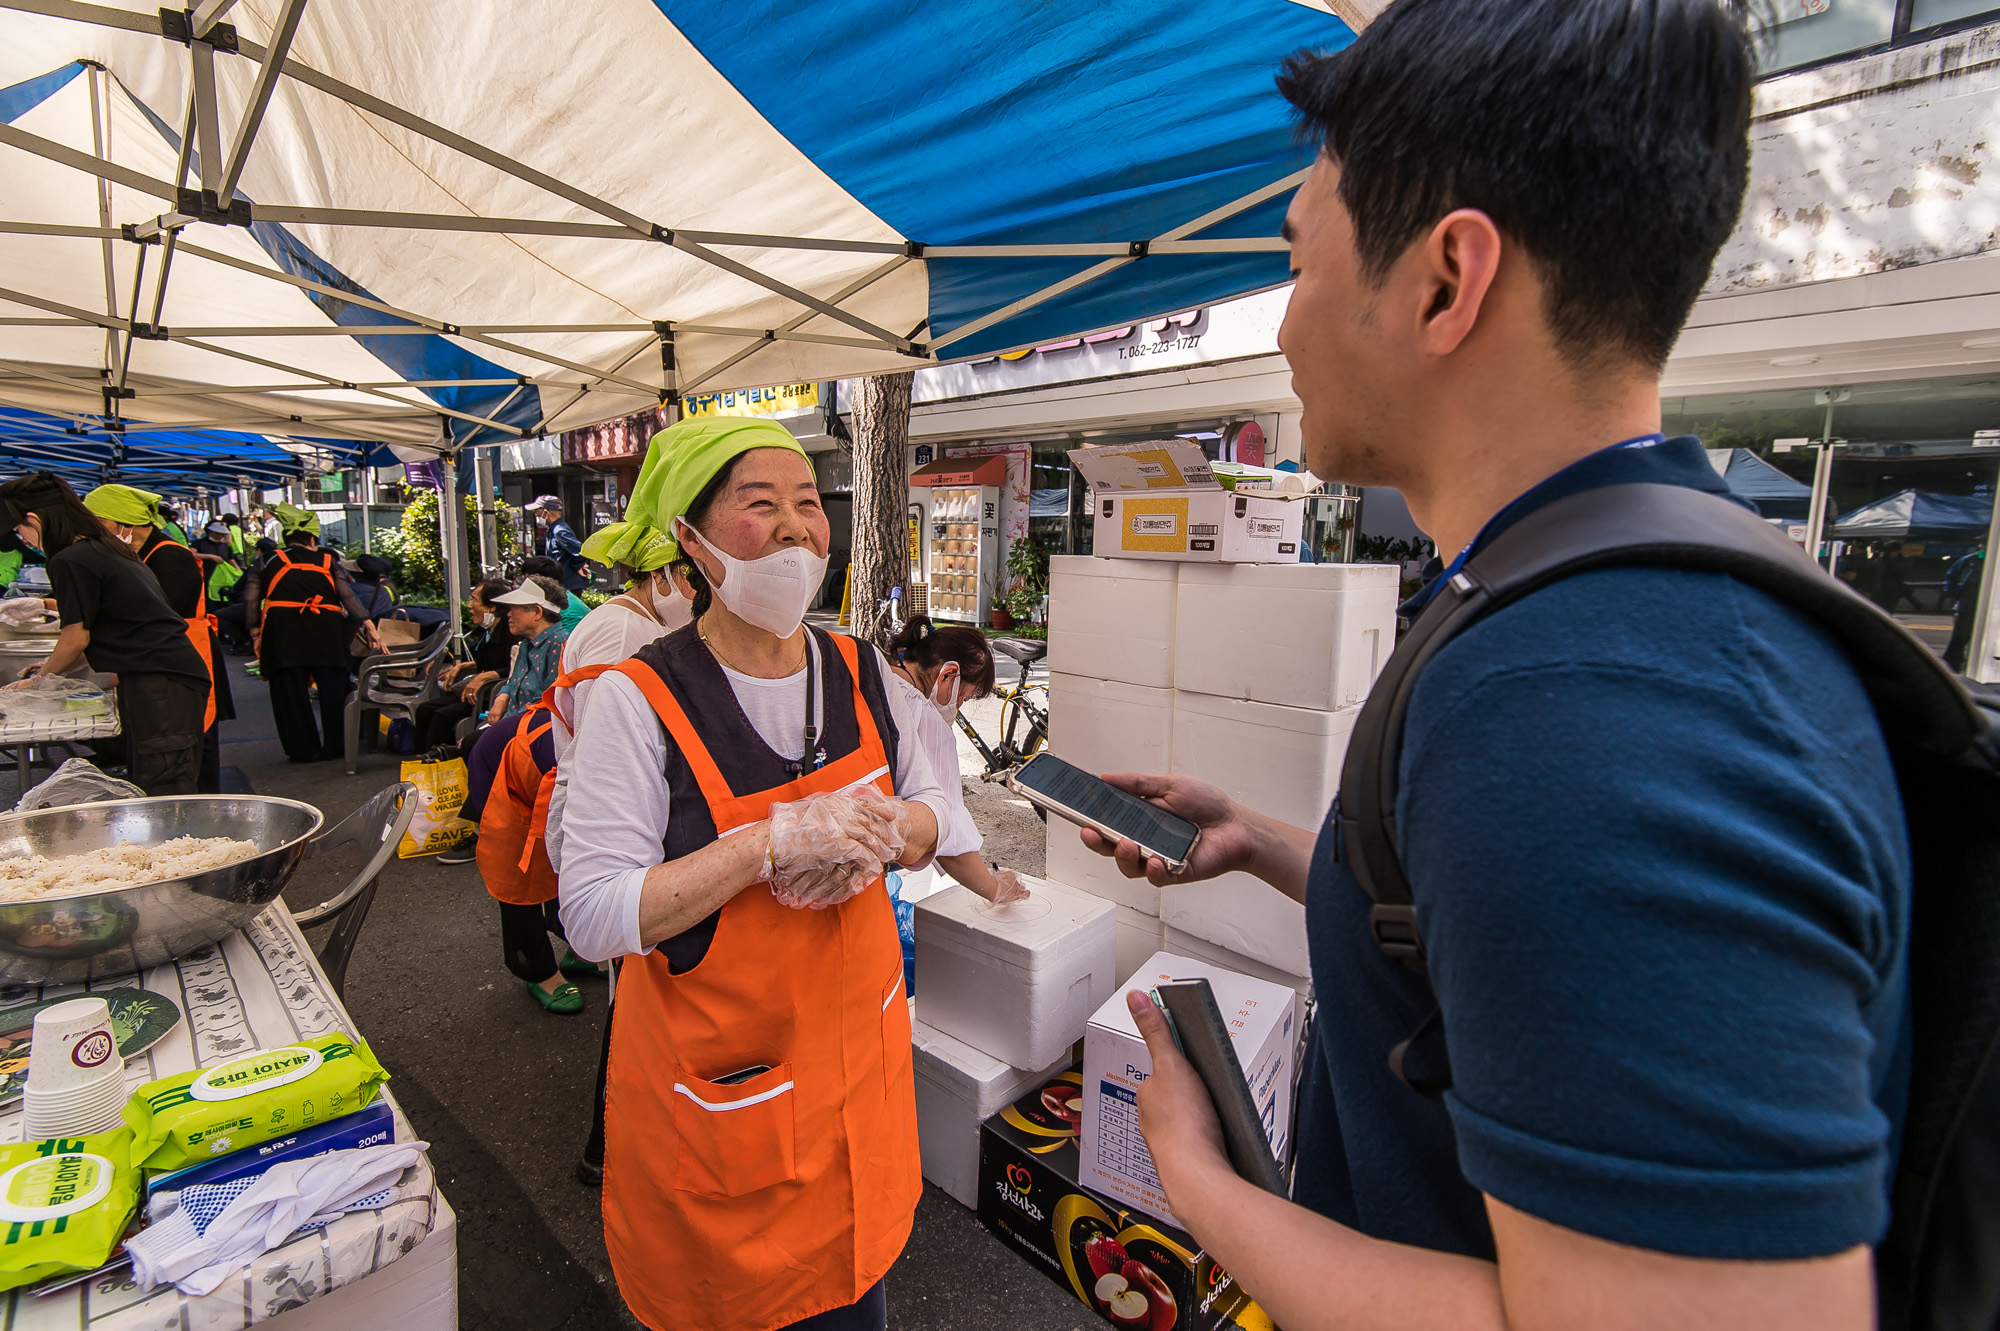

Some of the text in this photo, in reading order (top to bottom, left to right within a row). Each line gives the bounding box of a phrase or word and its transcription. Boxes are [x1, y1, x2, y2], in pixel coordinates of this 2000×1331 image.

[918, 455, 930, 464] 231
[984, 502, 995, 520] 꽃
[981, 527, 998, 538] 자판기
[782, 558, 797, 569] HD
[439, 785, 461, 795] LOVE
[437, 792, 462, 803] CLEAN
[434, 800, 463, 812] WATER
[429, 827, 470, 843] SAVE
[425, 841, 448, 851] OUR
[1105, 1071, 1129, 1085] Maximize
[358, 1130, 387, 1149] 200매
[995, 1180, 1045, 1222] 정선사과
